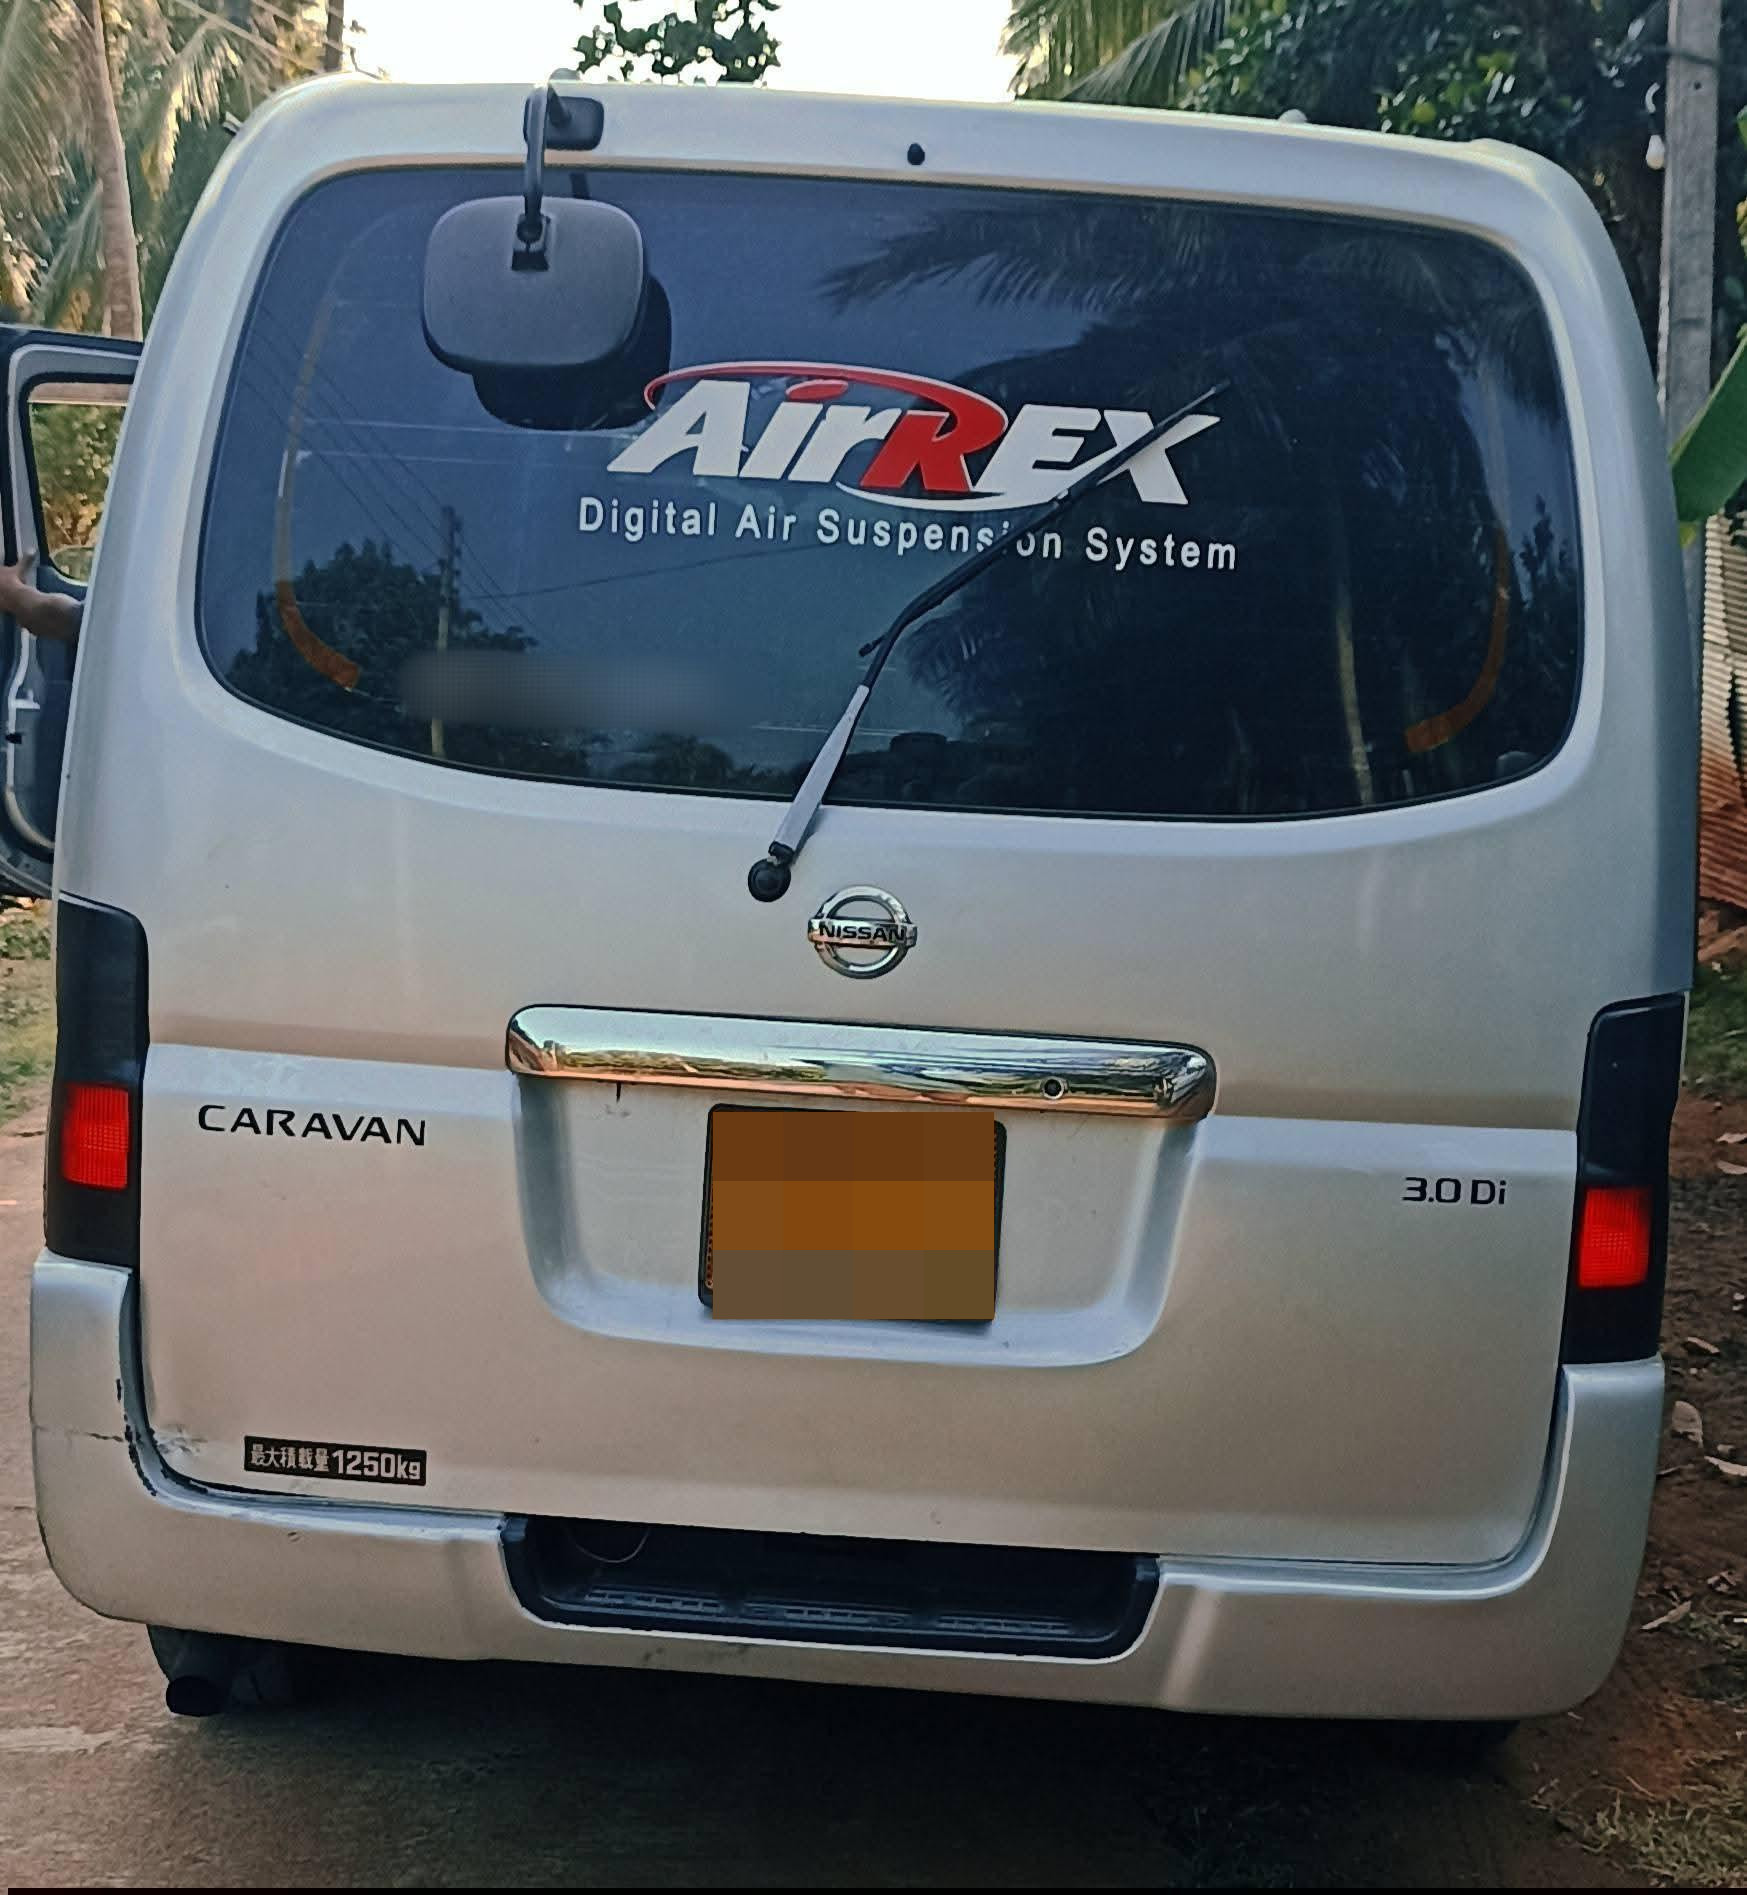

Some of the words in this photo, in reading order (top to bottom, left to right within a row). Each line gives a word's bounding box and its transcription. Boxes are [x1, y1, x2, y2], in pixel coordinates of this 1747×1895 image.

[578, 496, 717, 543] Digital
[735, 506, 797, 542] Air
[1085, 525, 1238, 572] System
[819, 922, 905, 941] NISSAN
[198, 1104, 426, 1146] CARAVAN
[1402, 1176, 1462, 1203] 3.0
[1470, 1179, 1507, 1205] Di
[332, 1449, 421, 1480] 1250kg
